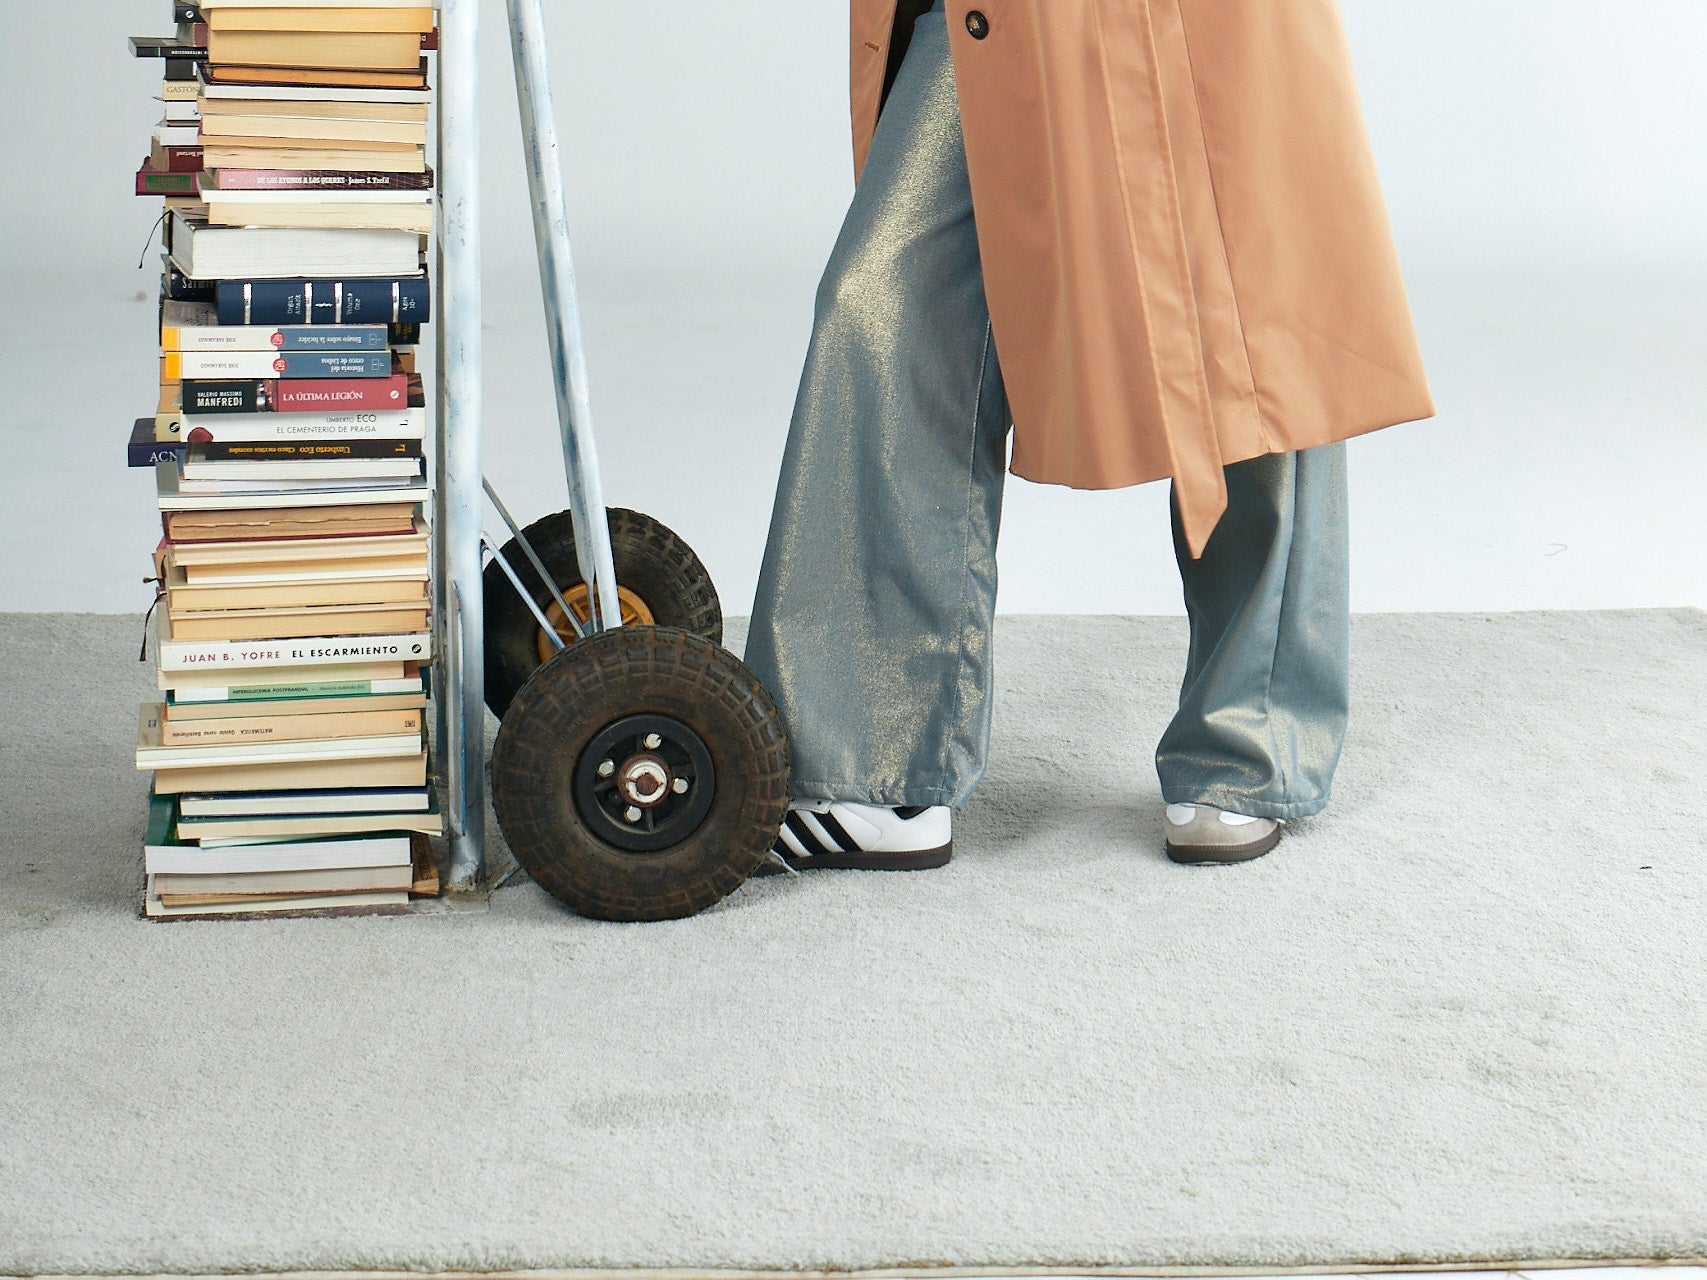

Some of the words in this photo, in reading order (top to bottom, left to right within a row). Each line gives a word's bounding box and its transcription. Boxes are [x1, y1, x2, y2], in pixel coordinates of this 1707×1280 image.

[348, 177, 365, 185] James
[299, 335, 319, 343] lucidez
[343, 336, 362, 344] Ensayo
[321, 357, 340, 365] Lisboa
[296, 391, 330, 401] ÚLTIMA
[331, 390, 363, 400] LEGIÓN
[197, 397, 243, 407] MANFREDI
[357, 414, 377, 422] ECO
[299, 446, 315, 454] Eco
[316, 446, 351, 454] Umberto
[183, 654, 215, 663] JUAN
[241, 651, 280, 660] YOFRE
[292, 650, 304, 658] EL
[310, 646, 398, 657] ESCARMIENTO
